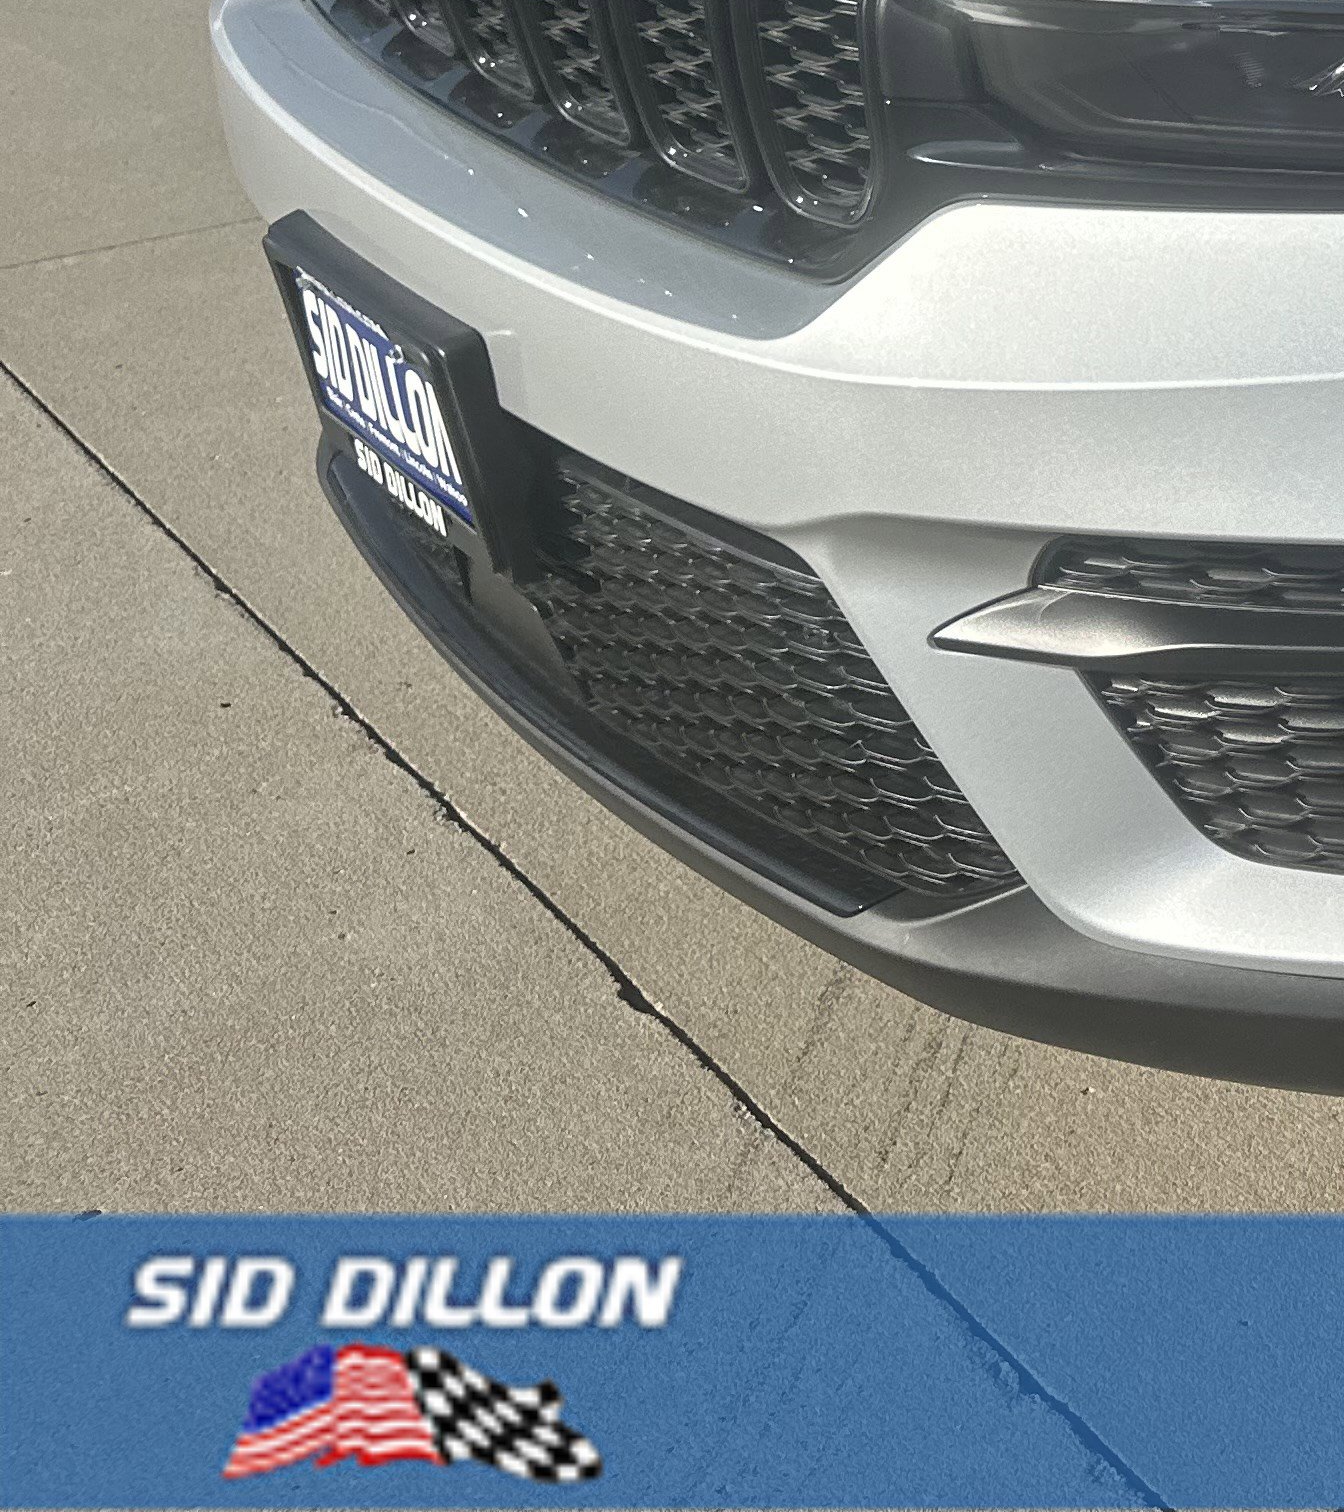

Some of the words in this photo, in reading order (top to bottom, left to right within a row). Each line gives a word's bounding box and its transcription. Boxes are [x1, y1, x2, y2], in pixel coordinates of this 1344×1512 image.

[302, 289, 354, 402] SID
[345, 322, 463, 486] DILLON
[354, 438, 384, 485] SID
[383, 461, 448, 538] DILLON
